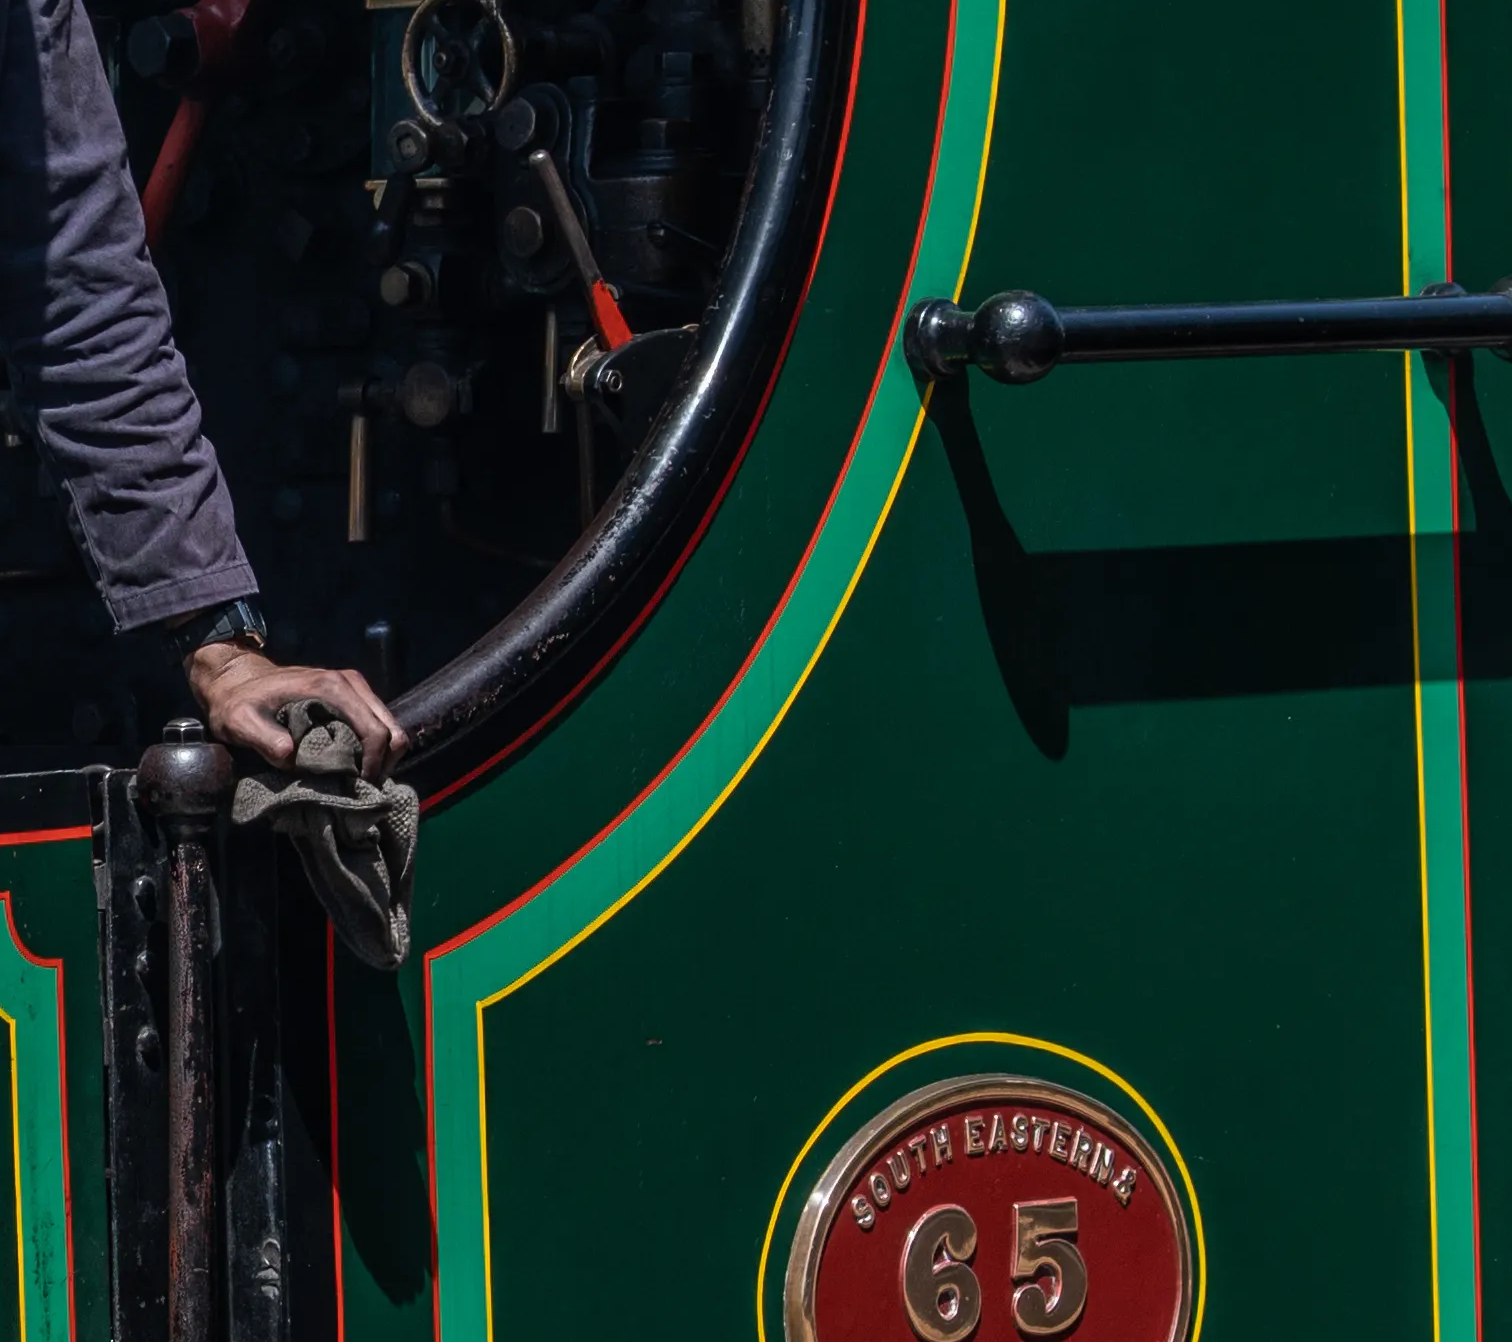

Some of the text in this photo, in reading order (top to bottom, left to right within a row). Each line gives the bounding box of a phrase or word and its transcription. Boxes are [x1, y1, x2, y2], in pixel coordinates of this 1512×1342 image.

[850, 1112, 1138, 1231] SOUTH EASTERN &
